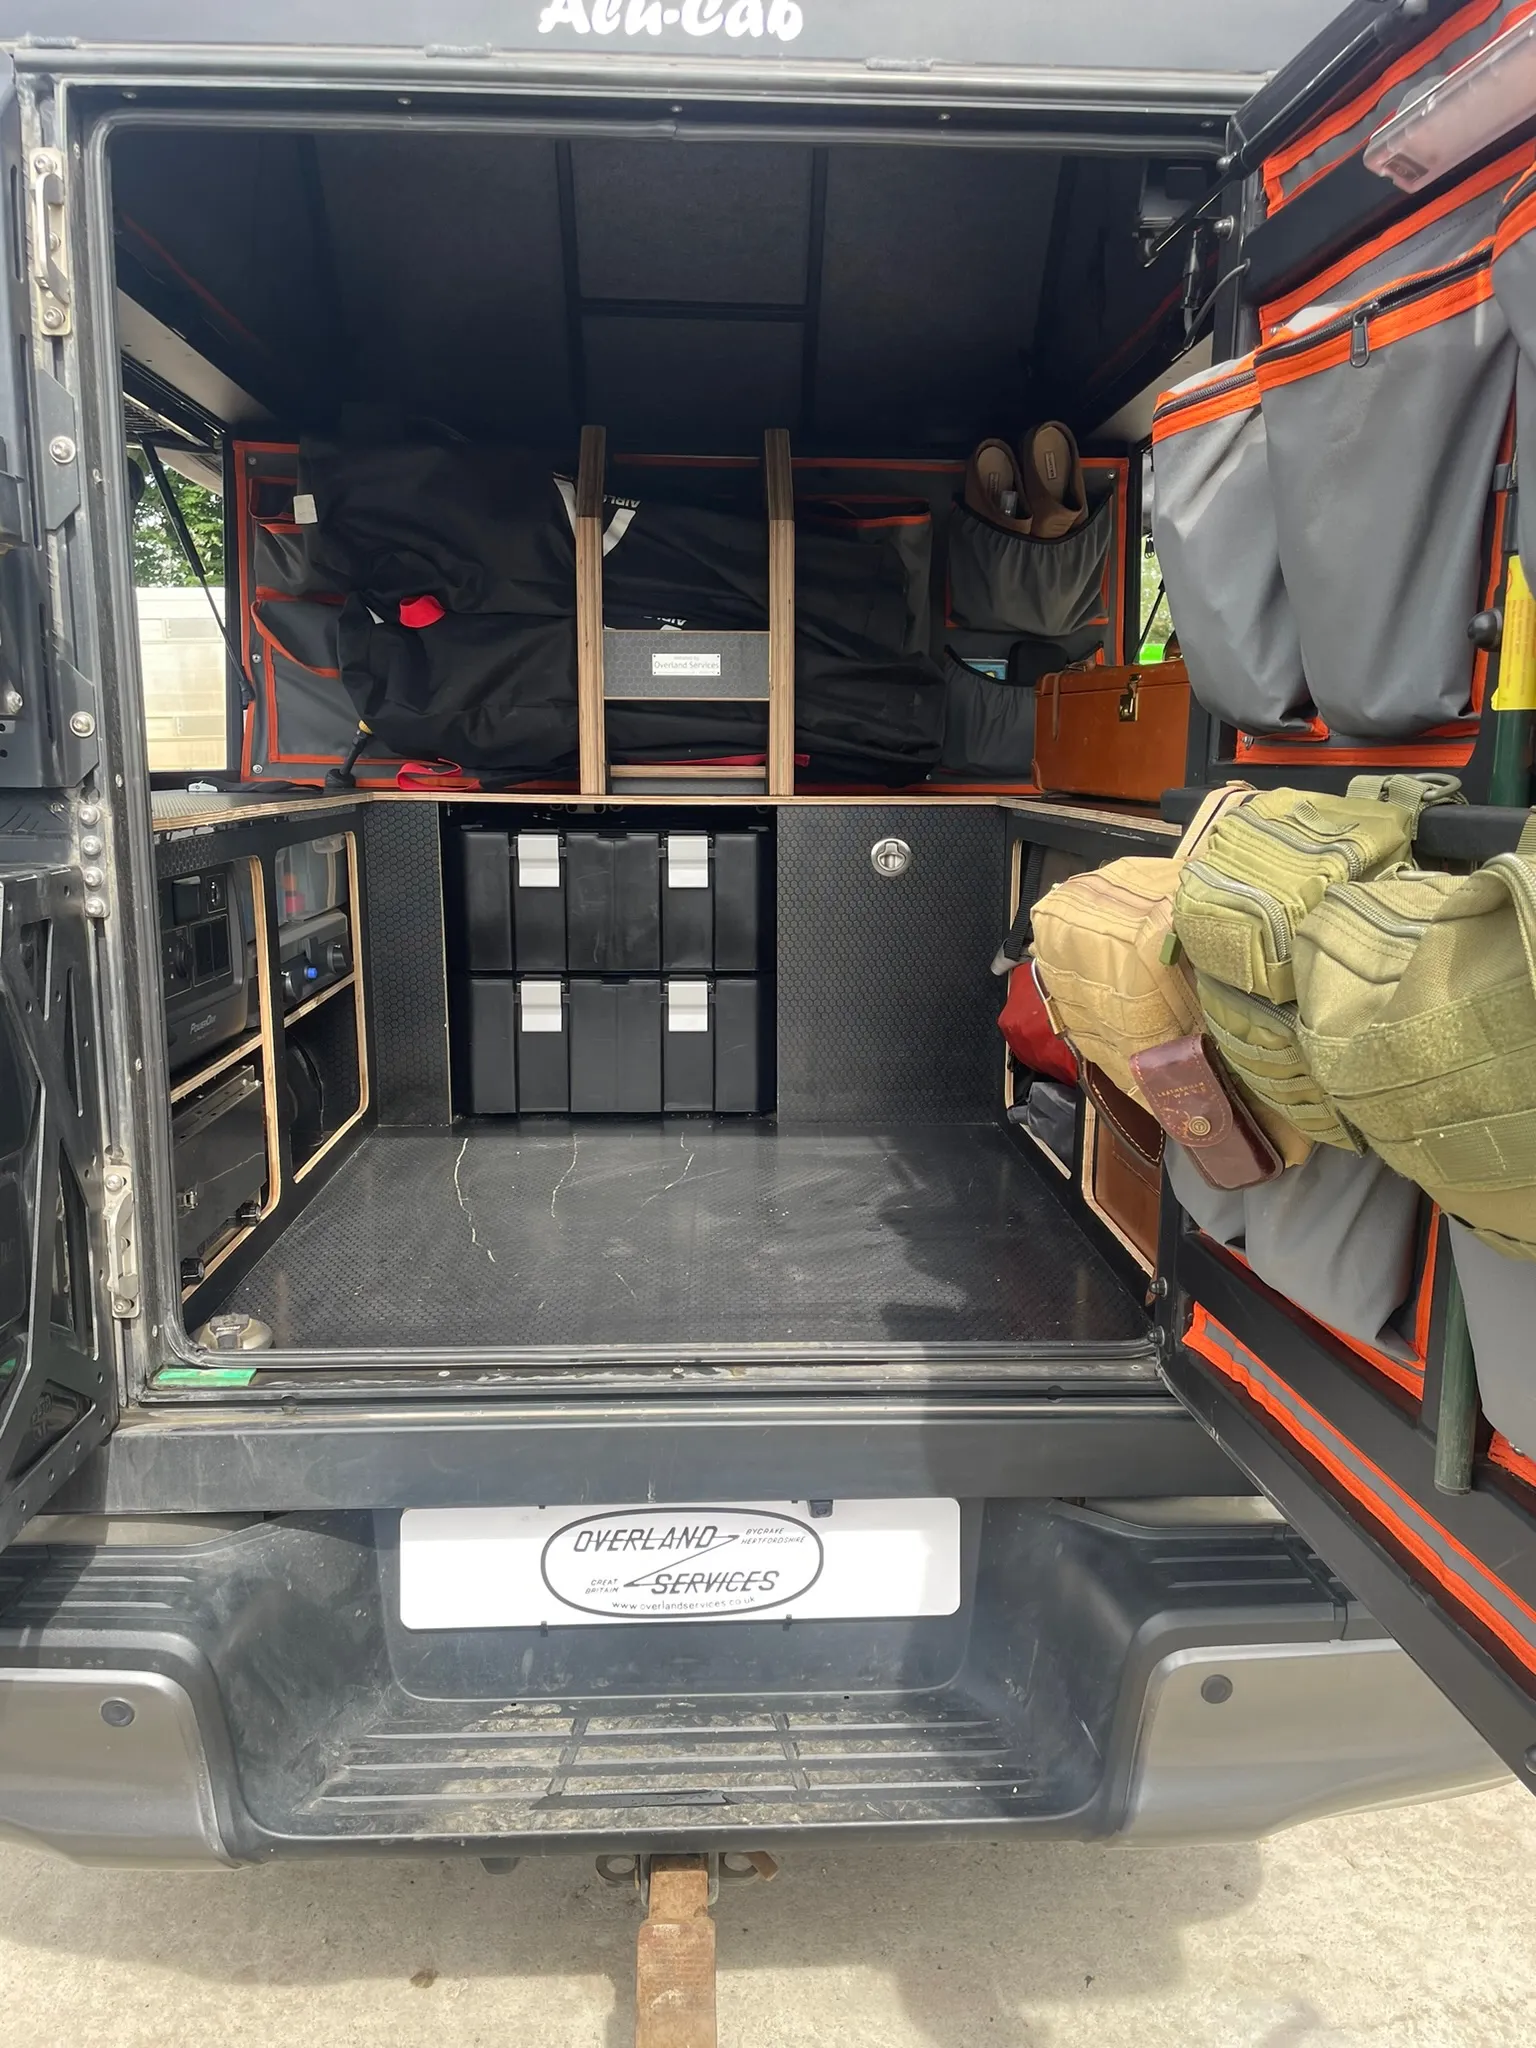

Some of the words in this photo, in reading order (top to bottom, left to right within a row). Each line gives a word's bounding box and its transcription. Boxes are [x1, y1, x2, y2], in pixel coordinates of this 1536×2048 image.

[654, 661, 687, 669] Overland
[689, 661, 719, 669] Services
[745, 1527, 785, 1535] BYCRAVE
[573, 1526, 718, 1552] OVERLAND
[740, 1536, 806, 1545] HERTFORDSHIRE
[590, 1578, 618, 1586] GREAT
[651, 1570, 780, 1594] SERVICES
[584, 1587, 619, 1595] BRITAIN
